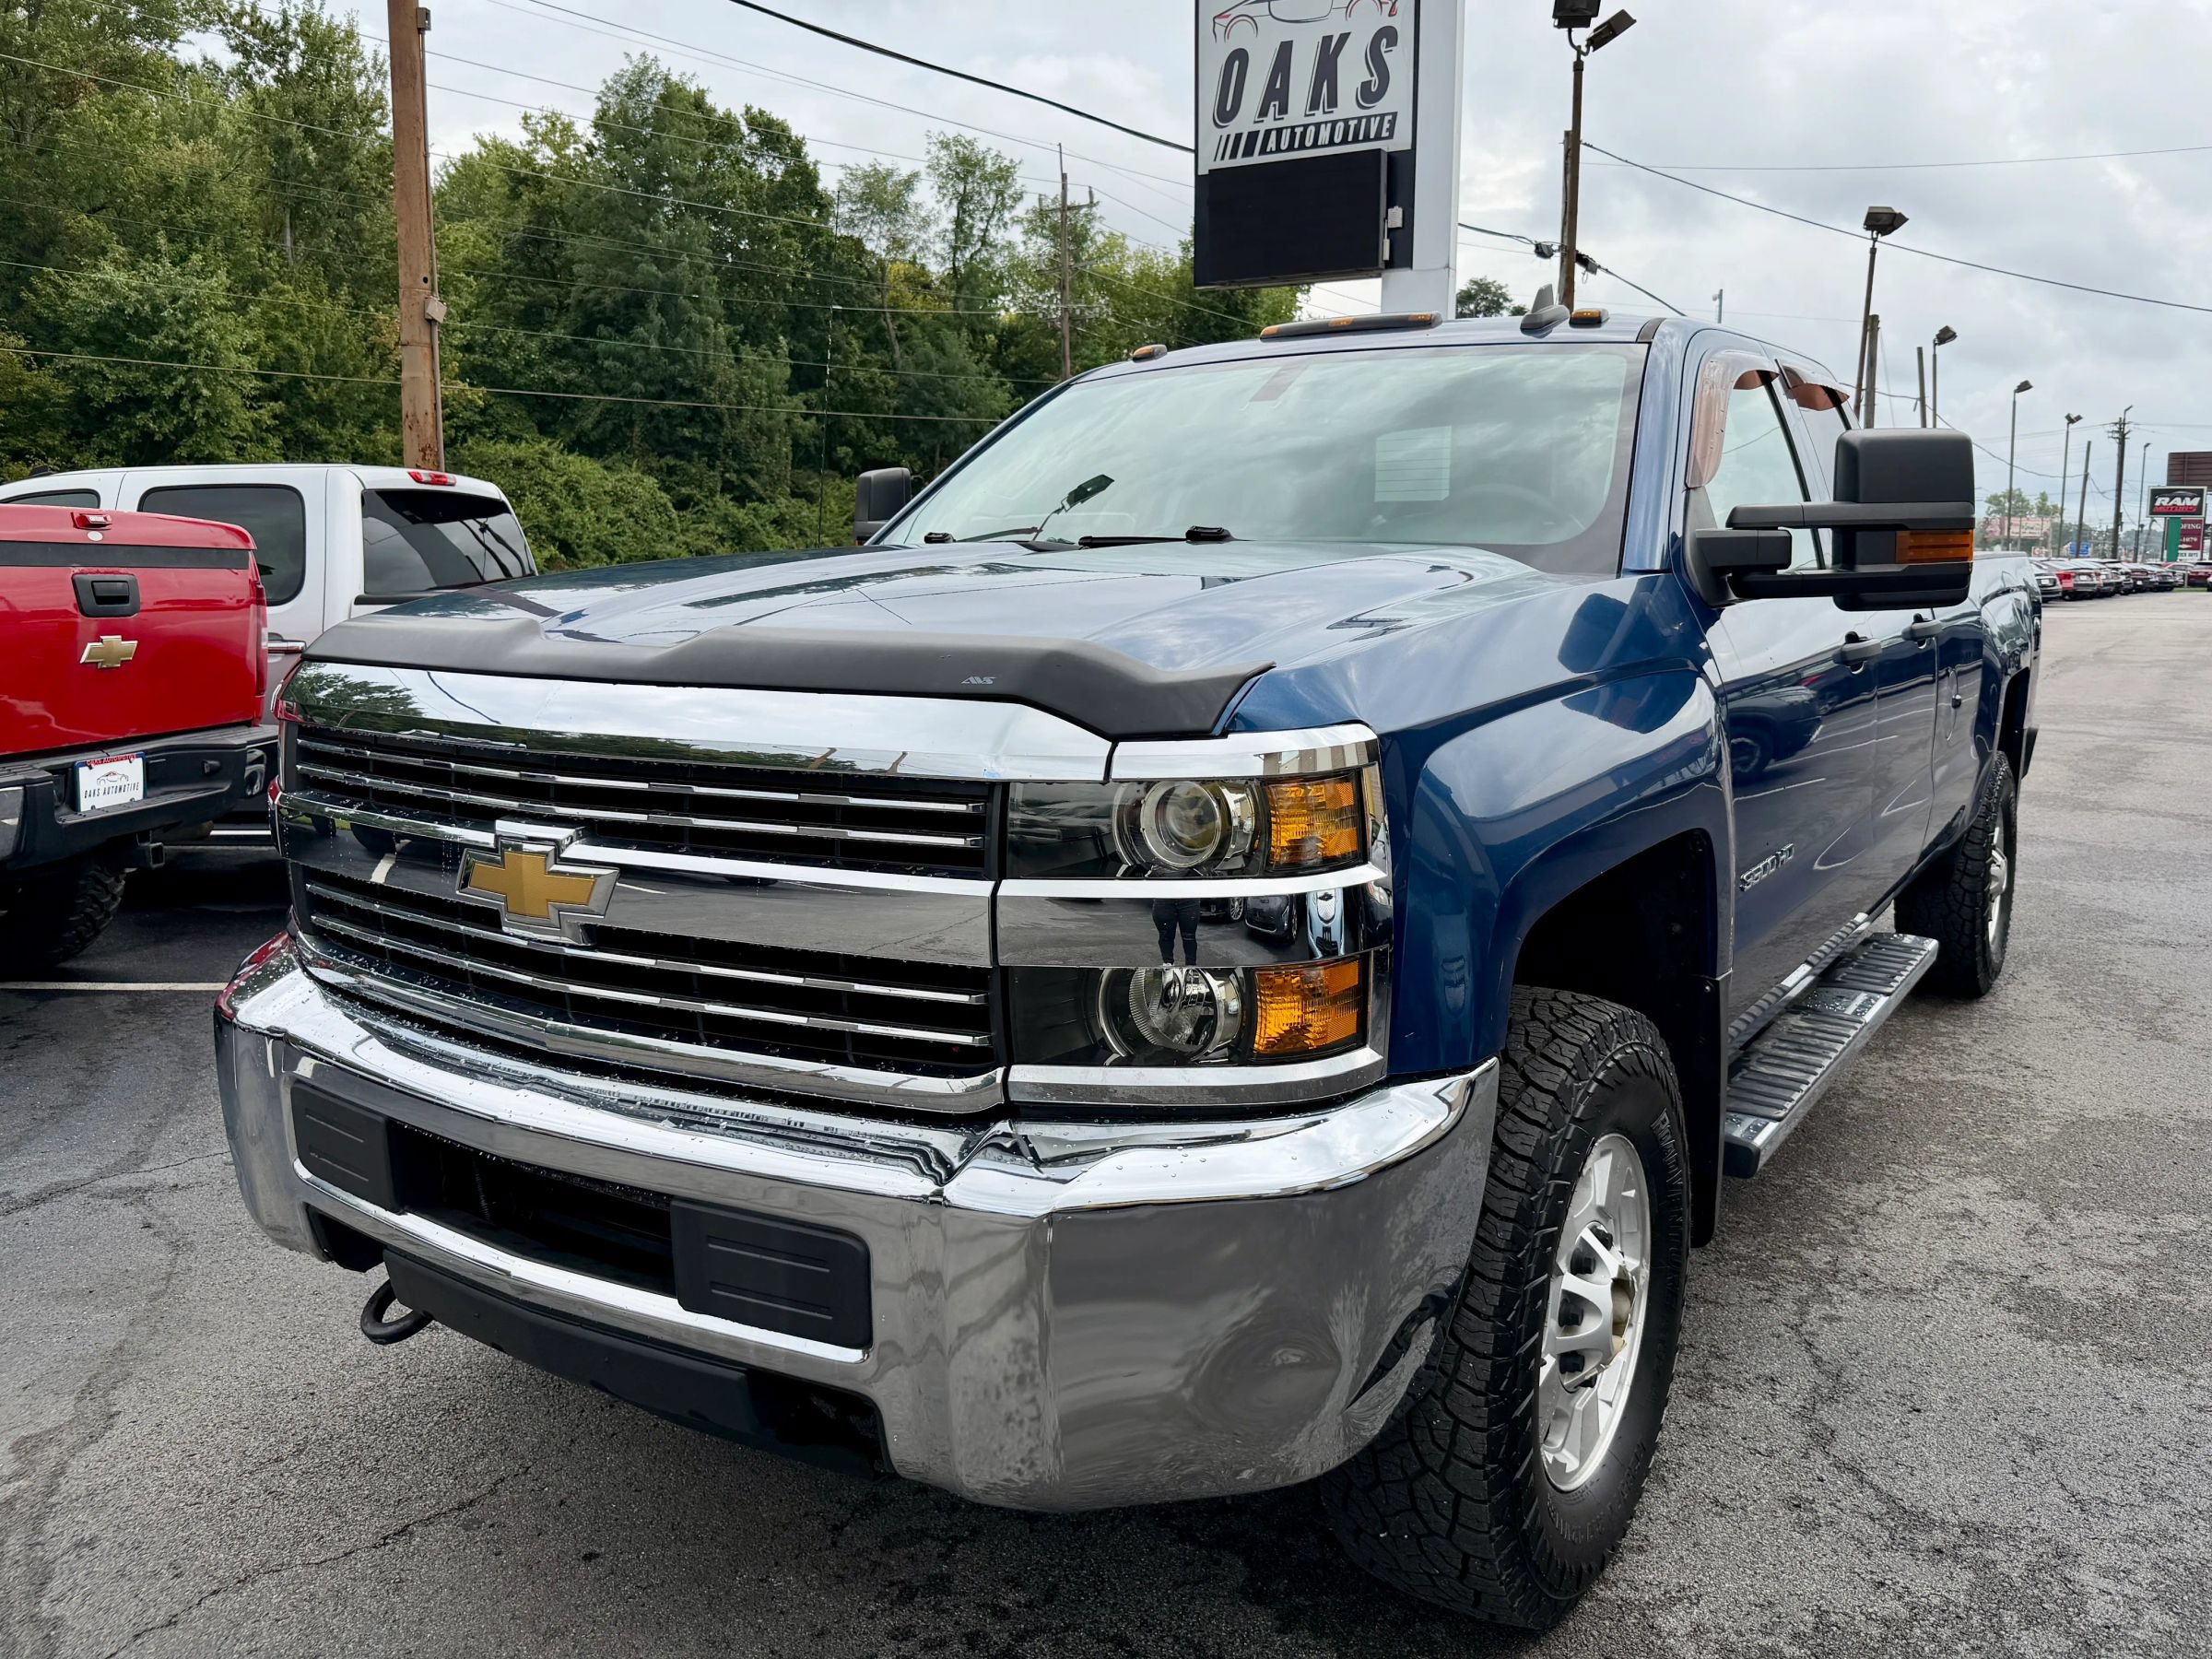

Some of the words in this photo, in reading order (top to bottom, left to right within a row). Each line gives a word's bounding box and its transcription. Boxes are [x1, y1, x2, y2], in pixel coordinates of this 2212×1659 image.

[1213, 25, 1398, 128] OAKS
[1267, 115, 1392, 152] AUTOMOTIVE
[2154, 496, 2201, 506] RAM
[961, 676, 996, 685] AVS
[85, 788, 100, 799] OAKS
[103, 782, 140, 795] AUTOMOTIVE
